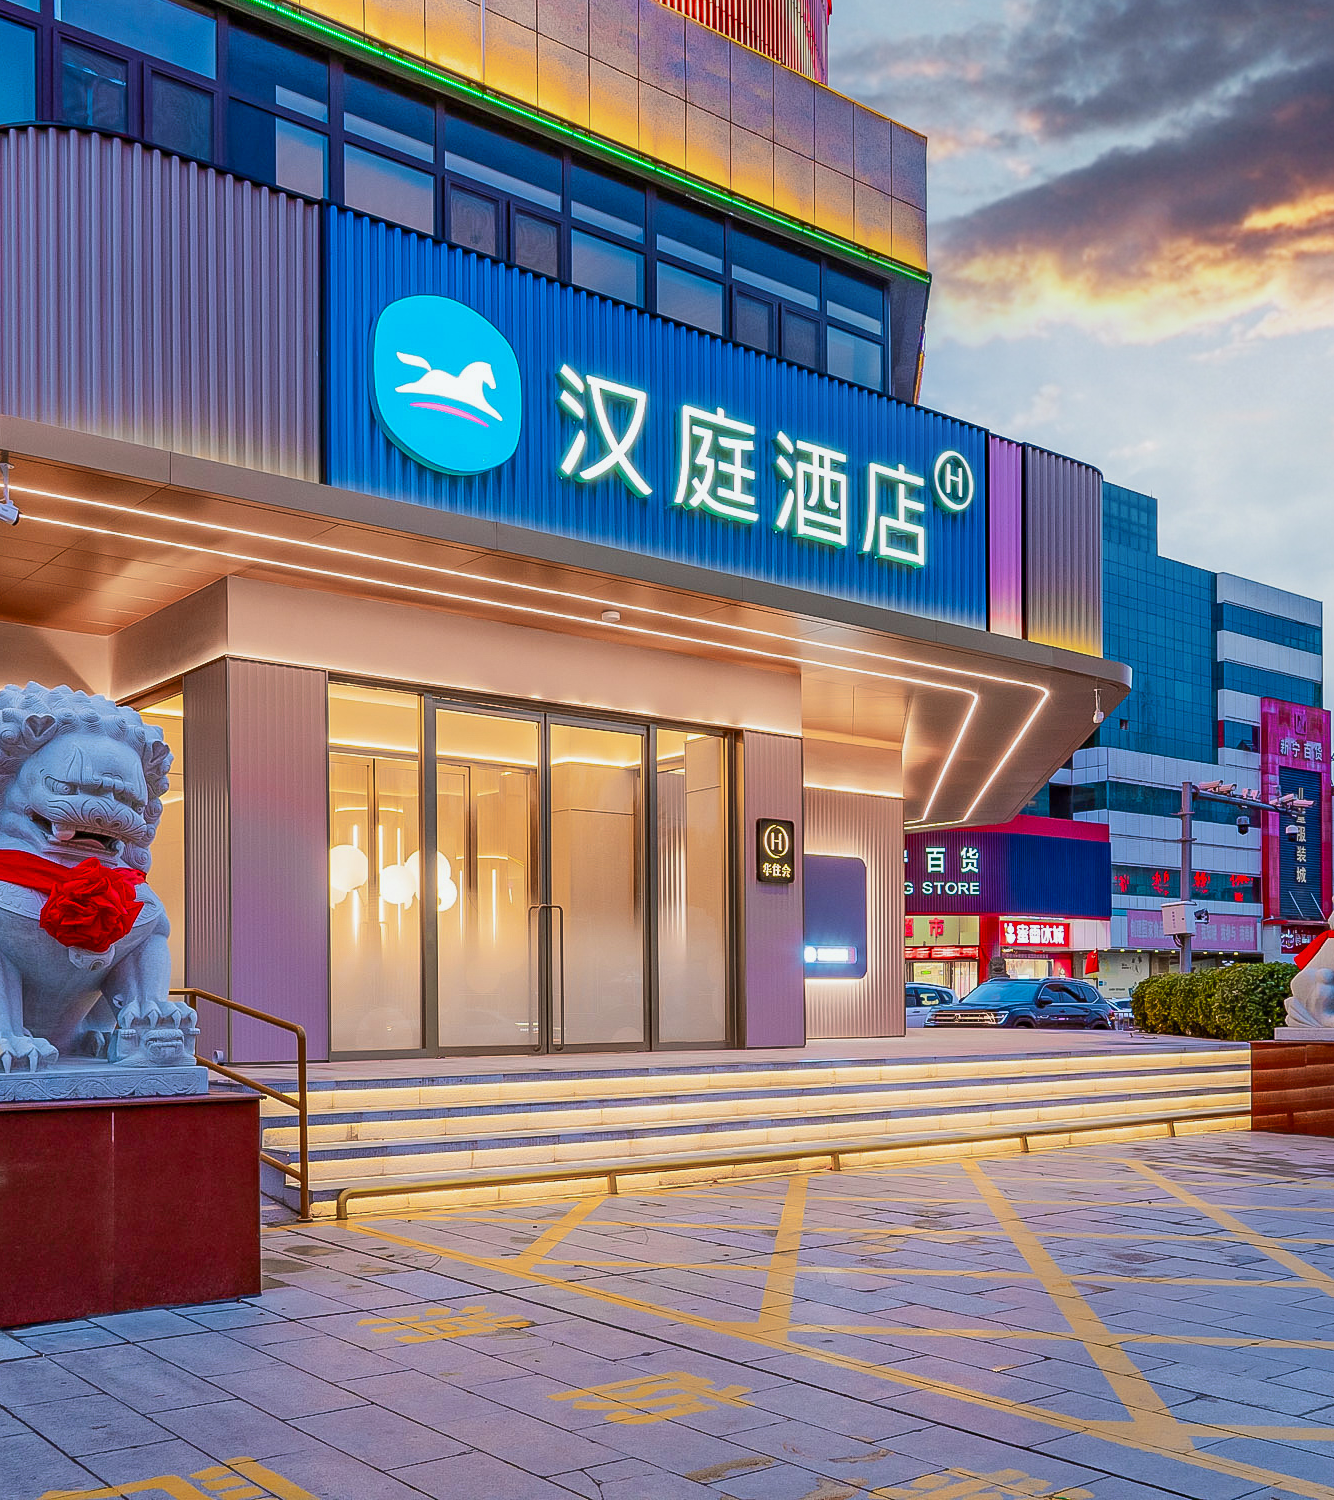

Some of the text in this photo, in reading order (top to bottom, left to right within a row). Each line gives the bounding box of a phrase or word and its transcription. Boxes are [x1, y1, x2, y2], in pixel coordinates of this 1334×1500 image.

[556, 363, 925, 568] 汉庭酒店
[762, 862, 792, 878] 华住会
[904, 846, 980, 874] 百货
[922, 882, 980, 895] STORE
[1017, 923, 1065, 944] 蜜雪冰城
